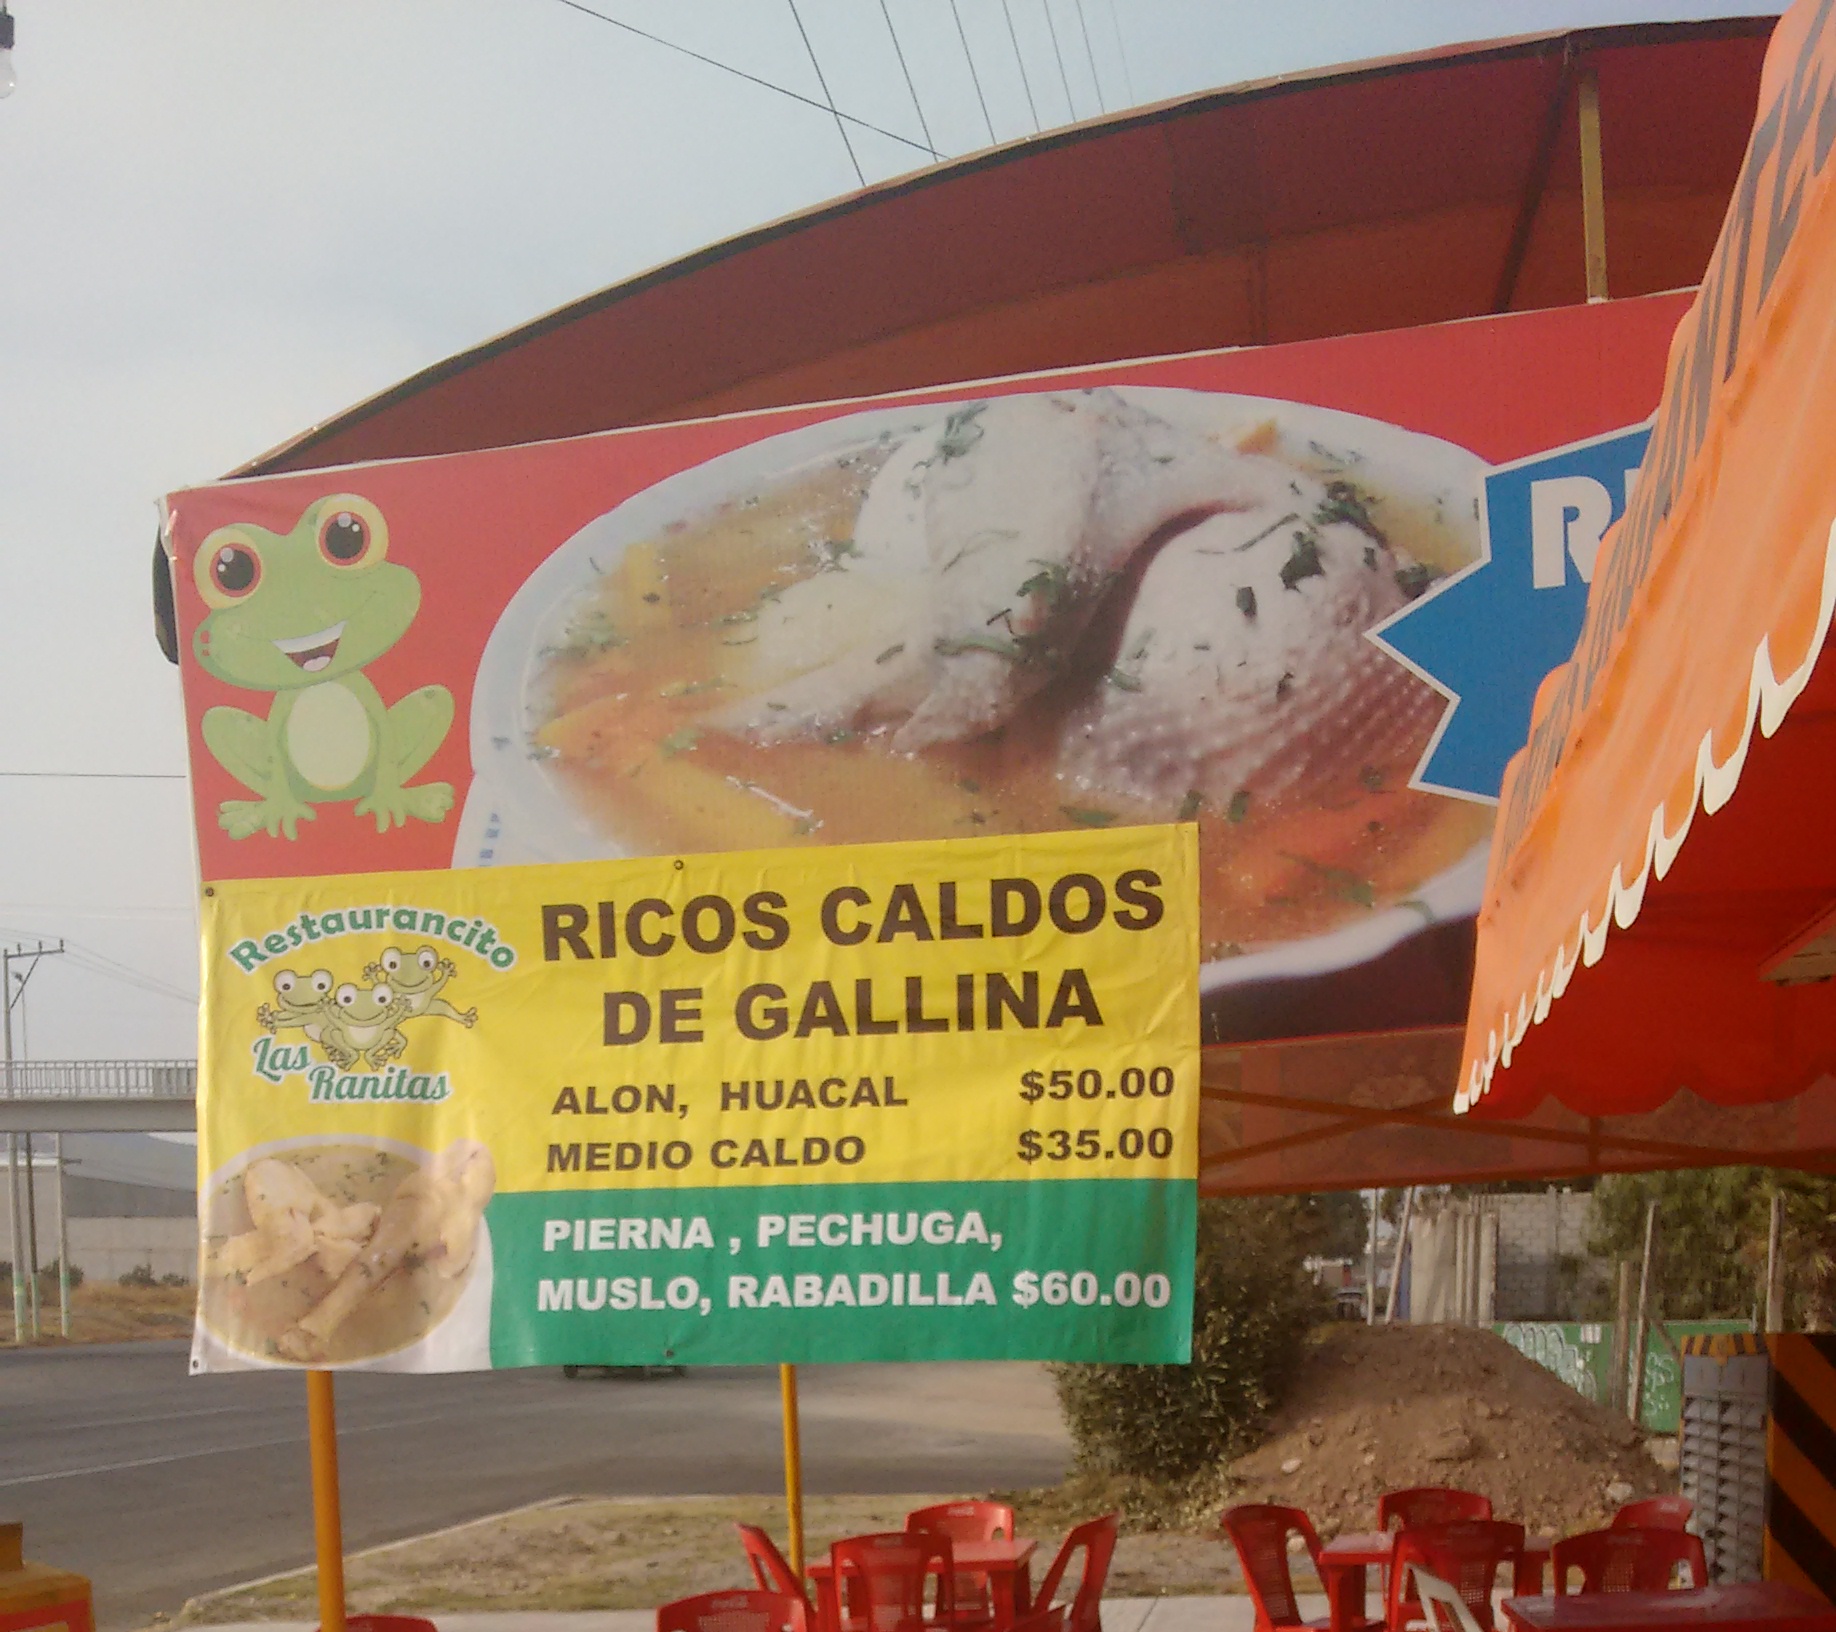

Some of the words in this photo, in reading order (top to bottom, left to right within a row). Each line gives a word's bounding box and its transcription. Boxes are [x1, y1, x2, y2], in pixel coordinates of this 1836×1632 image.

[542, 890, 790, 961] RICOS
[820, 868, 1165, 946] CALDOS
[230, 907, 515, 971] Restaurancito
[602, 988, 704, 1046] DE
[733, 968, 1104, 1041] GALLINA
[253, 1037, 311, 1082] Las
[308, 1066, 449, 1101] Ranitas
[551, 1083, 689, 1120] ALON,
[719, 1076, 908, 1112] HUACAL
[1018, 1066, 1174, 1105] $50.00
[546, 1140, 693, 1174] MEDIO
[709, 1135, 866, 1170] CALDO
[1017, 1127, 1174, 1165] $35.00
[756, 1211, 1003, 1253] PECHUGA,
[536, 1276, 712, 1316] MUSLO,
[727, 1272, 998, 1309] RABADILLA
[1012, 1270, 1172, 1309] $60.00
